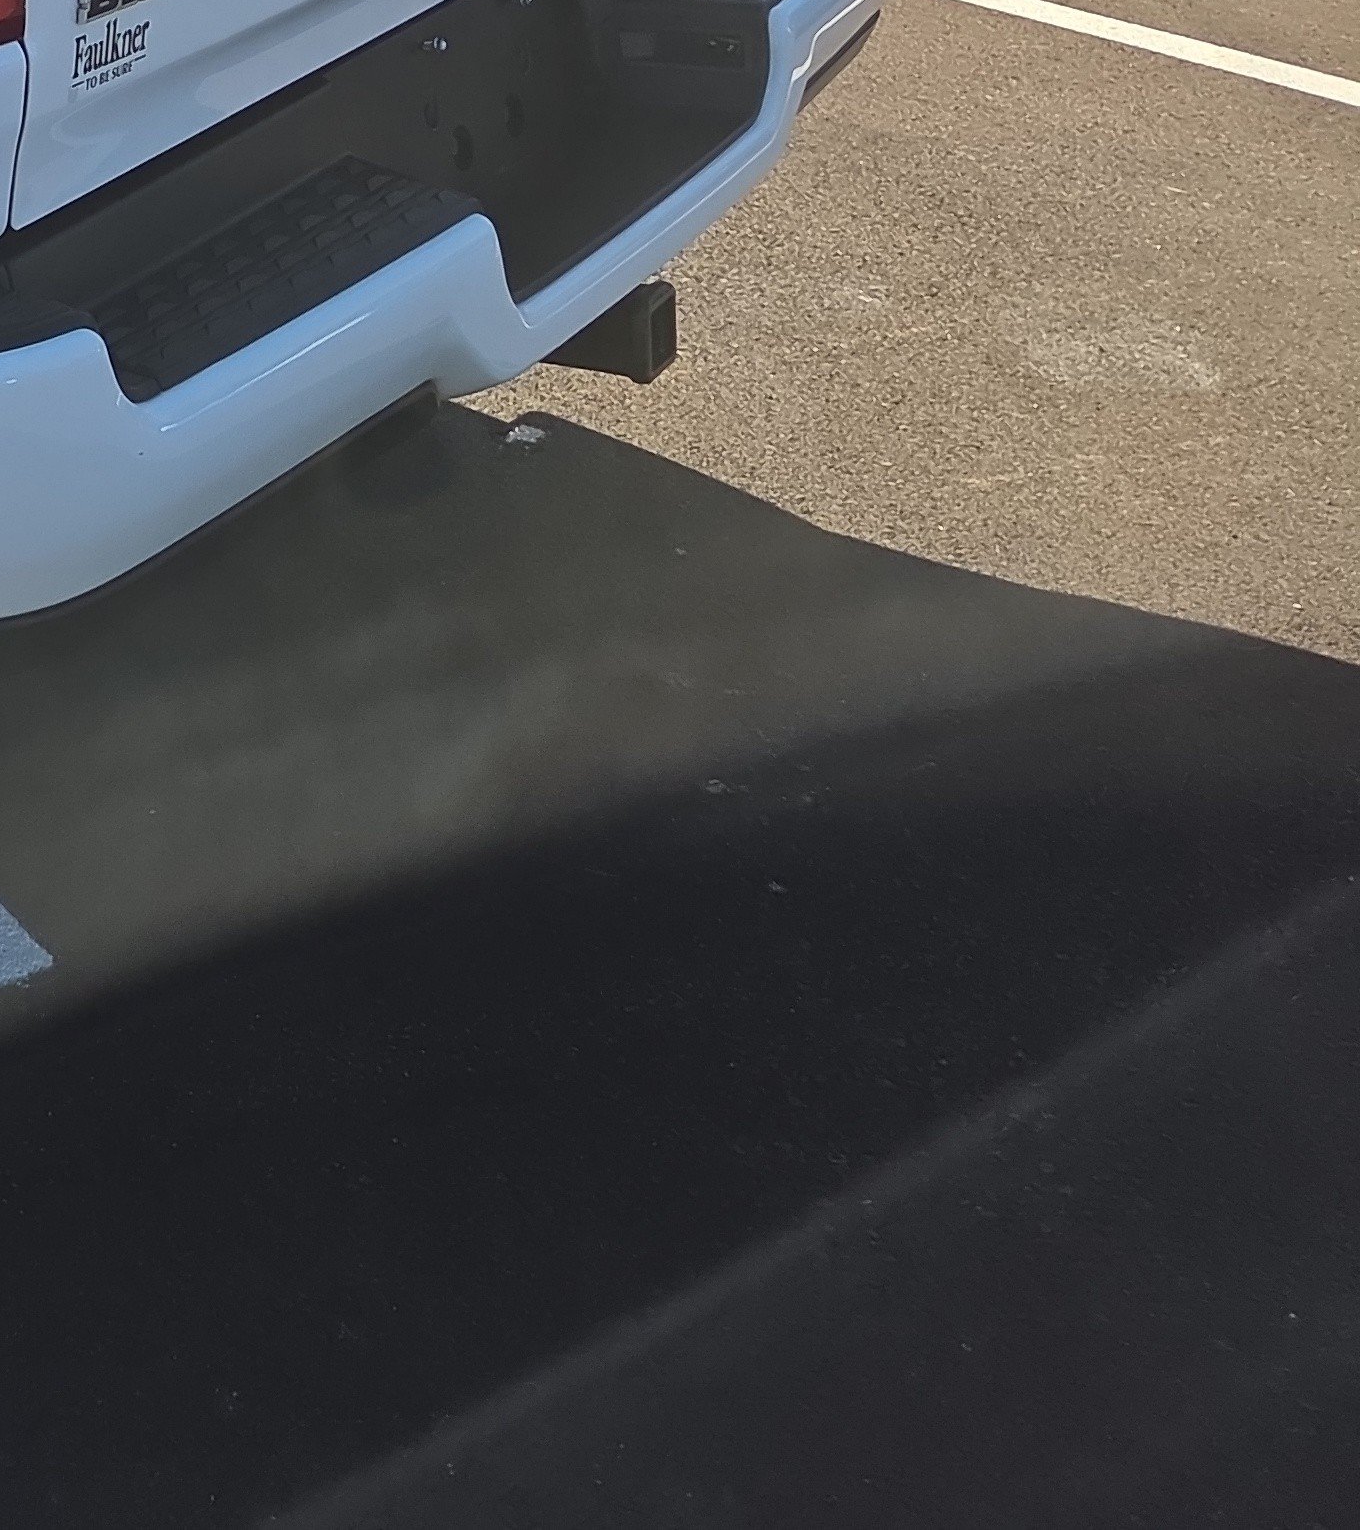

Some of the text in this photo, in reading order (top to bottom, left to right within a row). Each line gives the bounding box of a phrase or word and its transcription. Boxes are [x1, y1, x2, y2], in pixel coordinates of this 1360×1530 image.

[71, 17, 151, 79] Faulkner
[85, 60, 134, 91] TO BE SURE
